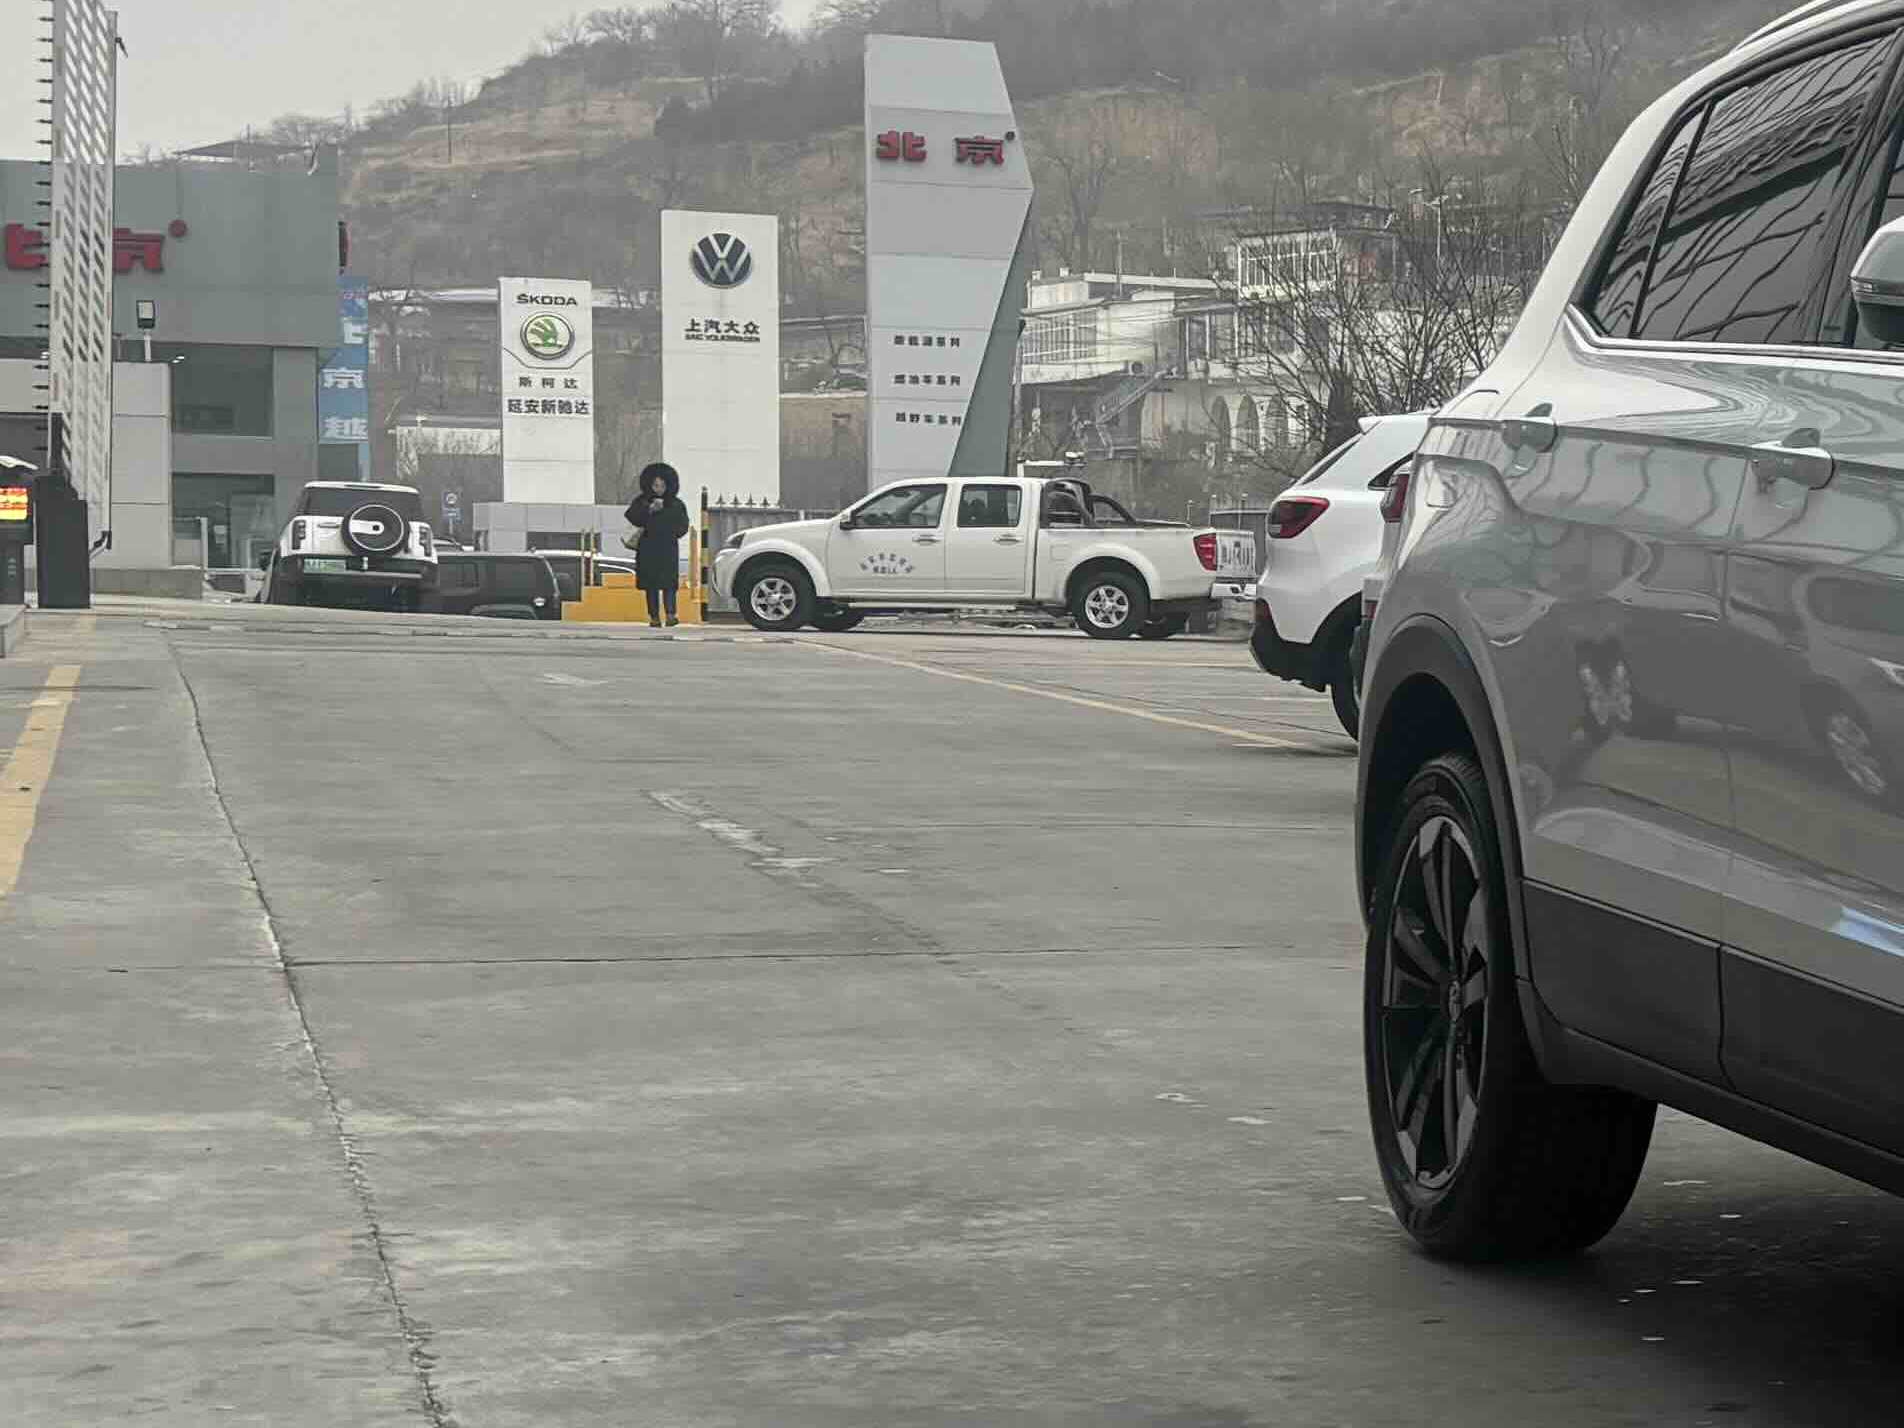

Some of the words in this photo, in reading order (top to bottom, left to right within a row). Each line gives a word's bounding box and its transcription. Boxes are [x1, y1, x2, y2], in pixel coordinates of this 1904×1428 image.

[876, 130, 1004, 165] 北京
[685, 318, 760, 334] 上汽大众
